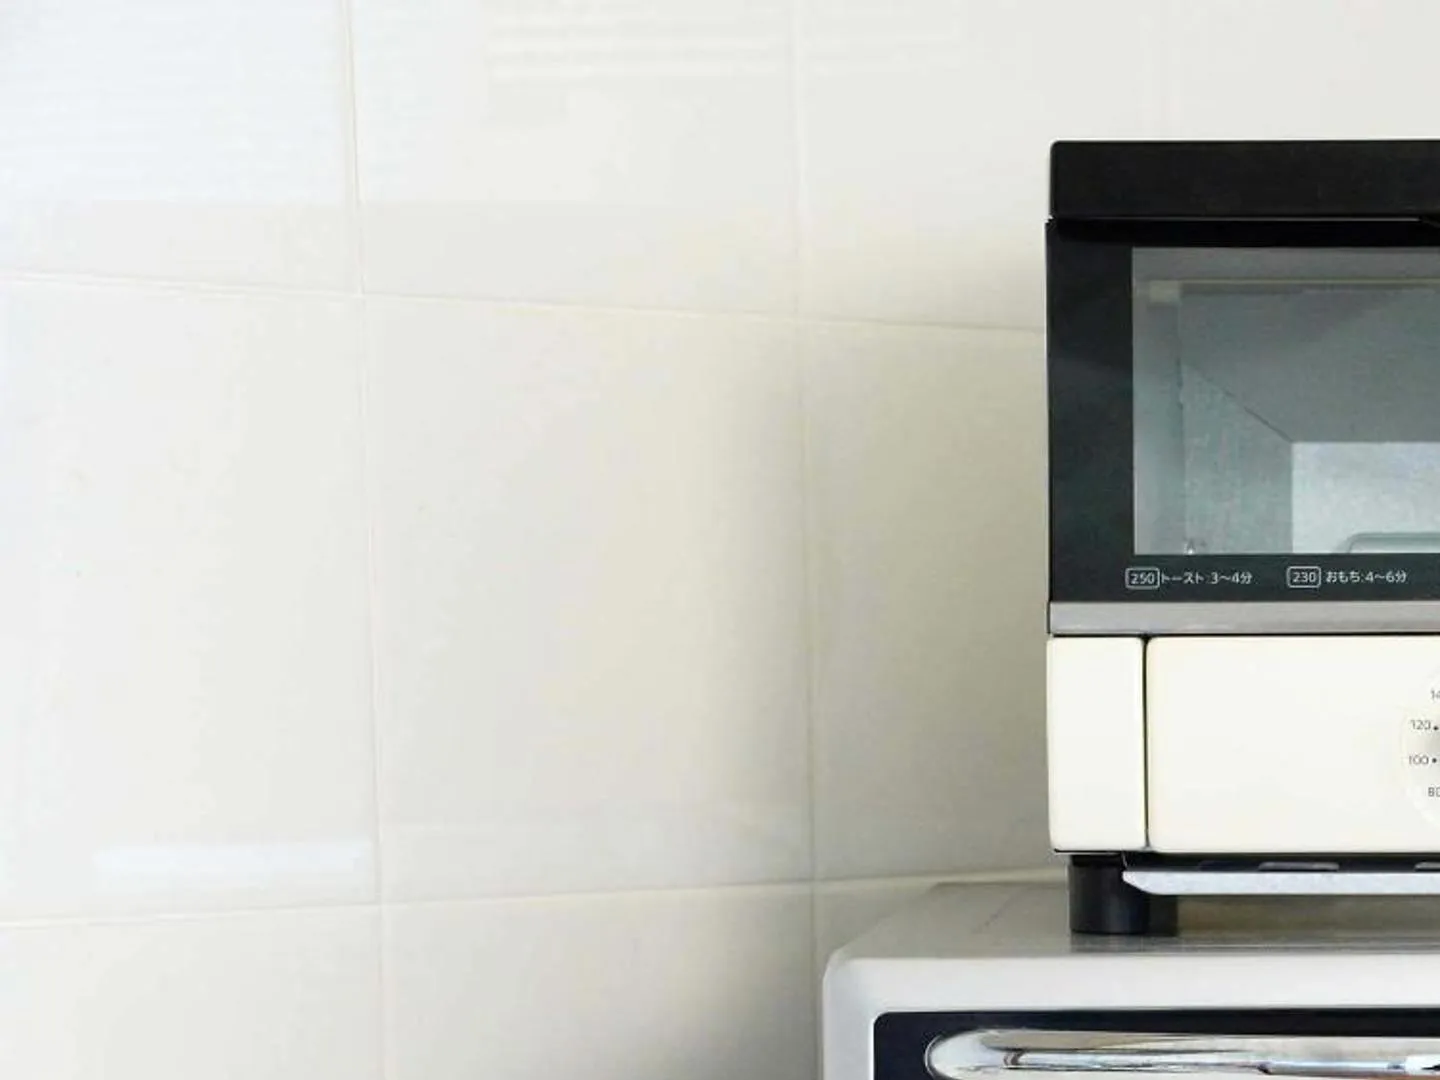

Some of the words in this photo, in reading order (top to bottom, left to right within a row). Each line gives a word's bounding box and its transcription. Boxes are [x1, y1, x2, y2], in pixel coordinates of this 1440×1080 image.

[1129, 573, 1156, 586] 250
[1292, 570, 1317, 584] 230
[1411, 720, 1431, 731] 120
[1408, 755, 1429, 765] 100
